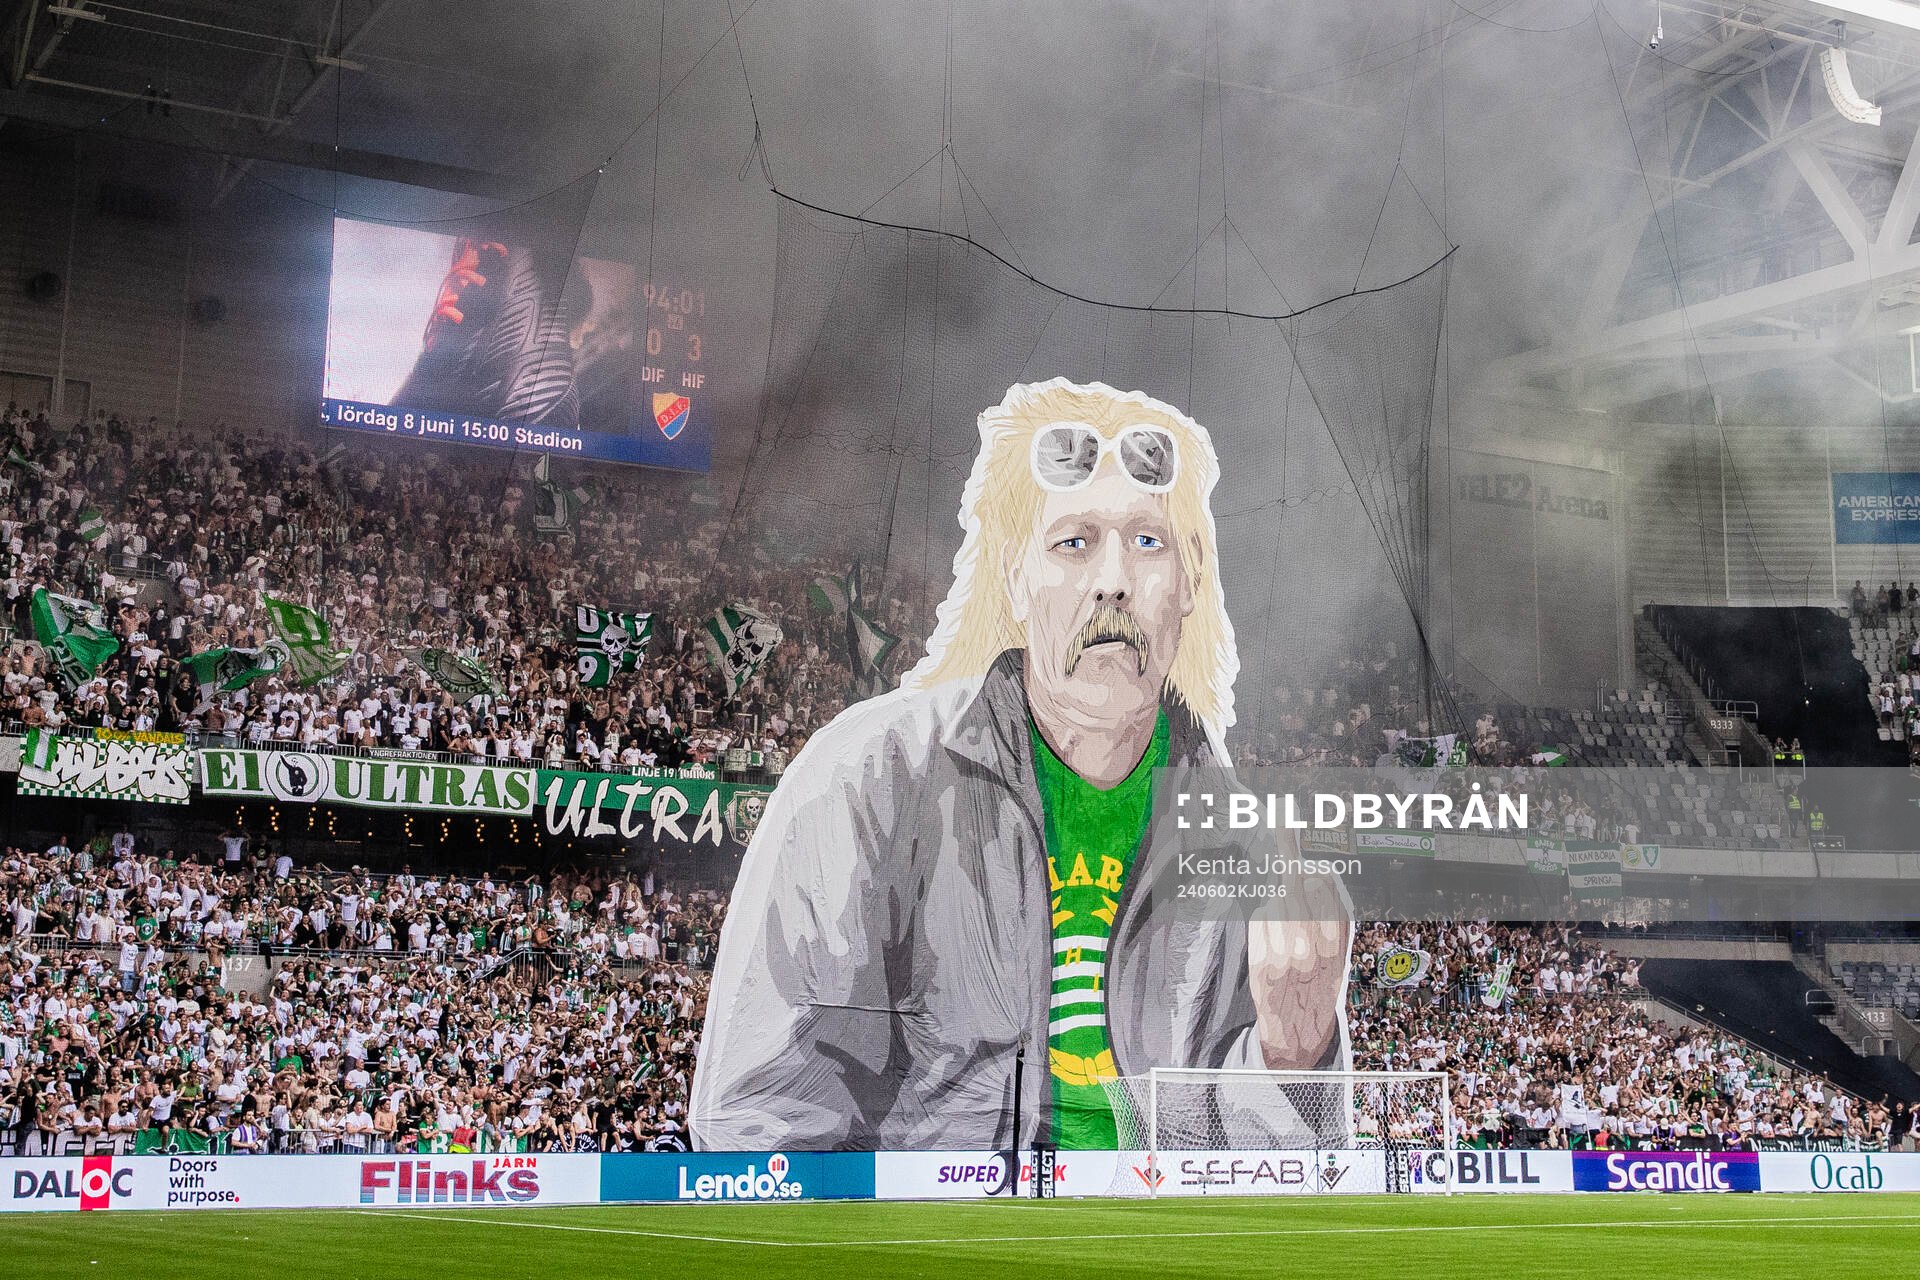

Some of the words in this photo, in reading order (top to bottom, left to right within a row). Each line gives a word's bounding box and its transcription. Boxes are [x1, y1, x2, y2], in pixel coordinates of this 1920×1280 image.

[646, 327, 661, 355] 0
[688, 335, 702, 362] 3
[642, 366, 665, 382] DIF
[682, 372, 705, 389] HIF
[337, 404, 398, 430] lördag
[403, 413, 414, 429] 8
[418, 414, 455, 436] juni
[461, 420, 509, 441] 15:00
[514, 427, 583, 450] Stadion
[1851, 509, 1920, 521] EXPRES
[134, 730, 185, 744] VANDALS
[333, 758, 532, 811] ULTRAS
[631, 765, 661, 778] LINJE
[664, 766, 675, 778] 19
[544, 776, 724, 848] ULTRA
[169, 1157, 217, 1172] Doors
[492, 1155, 537, 1168] JÄRN
[937, 1164, 999, 1183] SUPER
[1020, 1164, 1067, 1182] DK
[1042, 1151, 1054, 1199] SELECT
[1606, 1152, 1730, 1191] Scandic
[1810, 1153, 1884, 1190] Ocab
[13, 1167, 134, 1199] DALOC
[169, 1173, 204, 1188] with
[360, 1160, 539, 1203] Flinks
[679, 1164, 803, 1200] Lendo.se
[167, 1190, 240, 1206] purpose.
